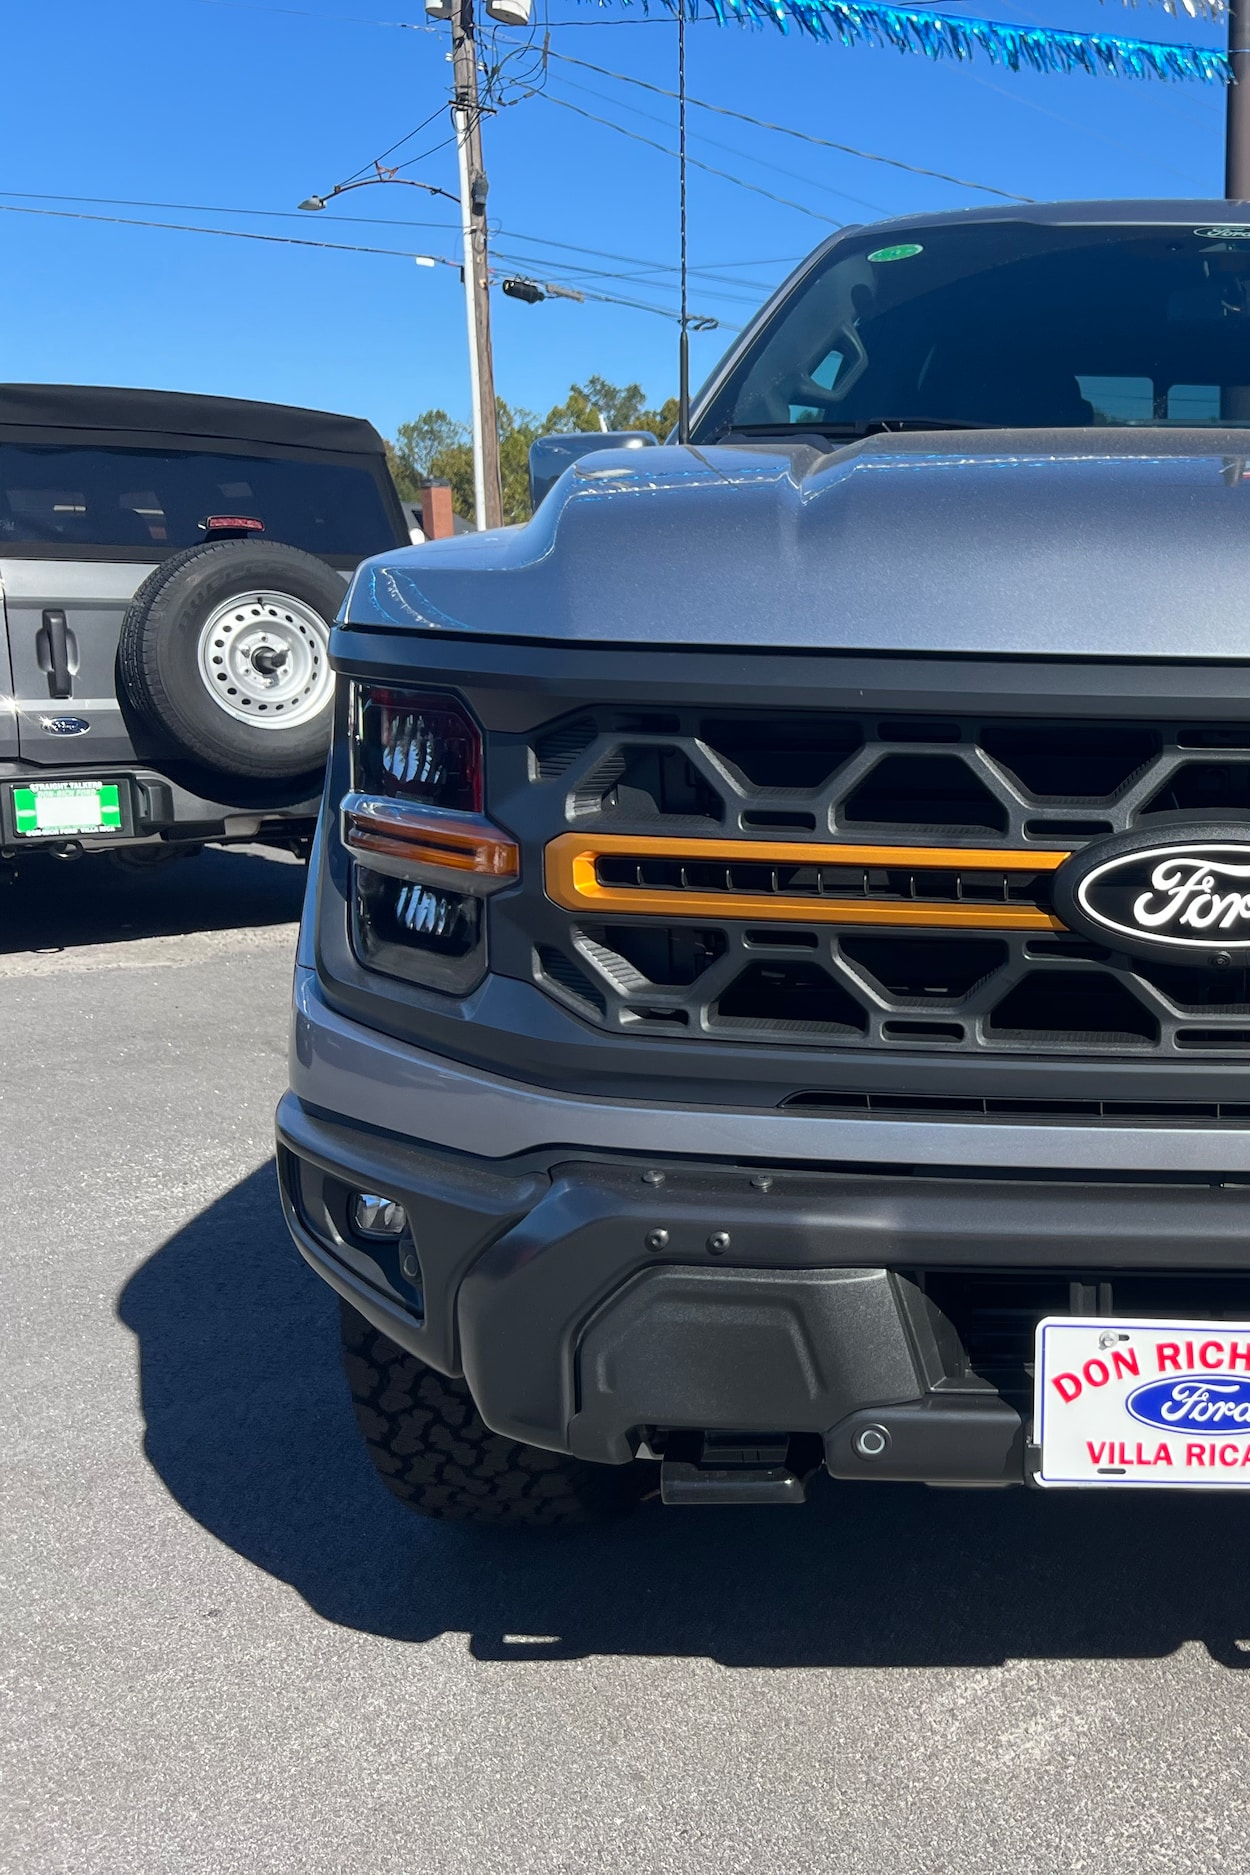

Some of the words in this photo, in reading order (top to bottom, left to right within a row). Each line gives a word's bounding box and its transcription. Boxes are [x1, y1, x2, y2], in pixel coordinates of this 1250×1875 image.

[29, 783, 68, 792] STRAIGHT
[69, 781, 102, 789] TALKERS
[1051, 1346, 1141, 1405] DON
[1086, 1440, 1173, 1467] VILLA
